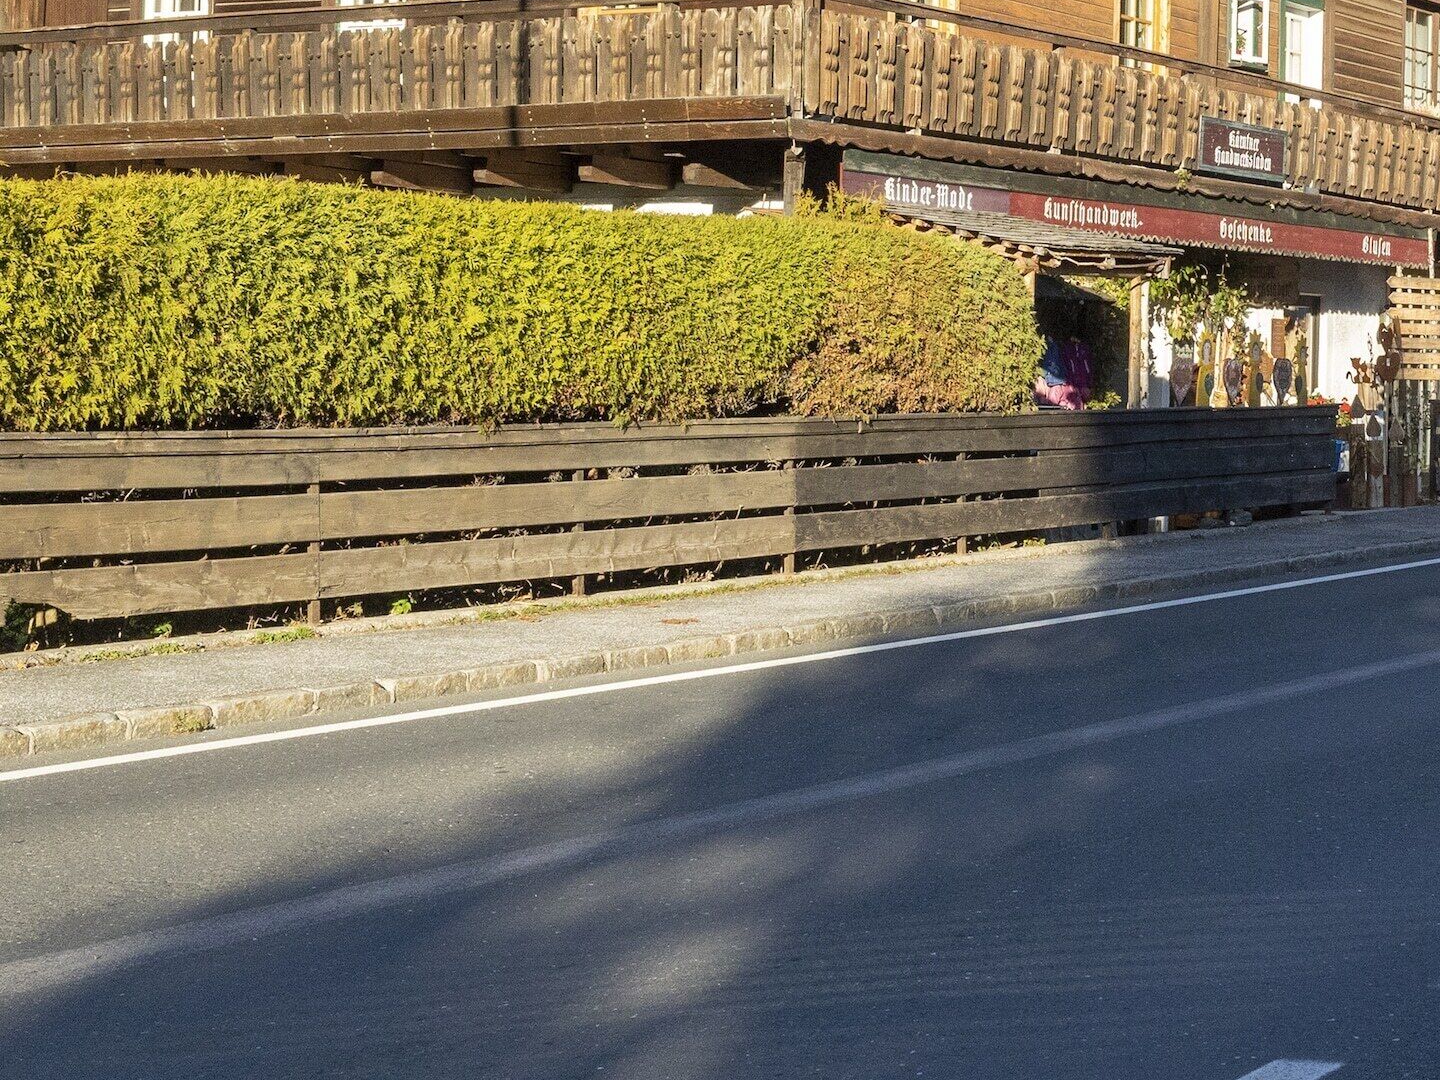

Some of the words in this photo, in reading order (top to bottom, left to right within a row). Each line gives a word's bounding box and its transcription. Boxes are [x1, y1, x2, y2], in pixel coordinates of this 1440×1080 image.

[884, 177, 974, 211] Kinder-Mode
[1043, 196, 1144, 229] Kunsthandwerk
[1219, 217, 1274, 244] Geschenke
[1361, 235, 1391, 258] Blusen
